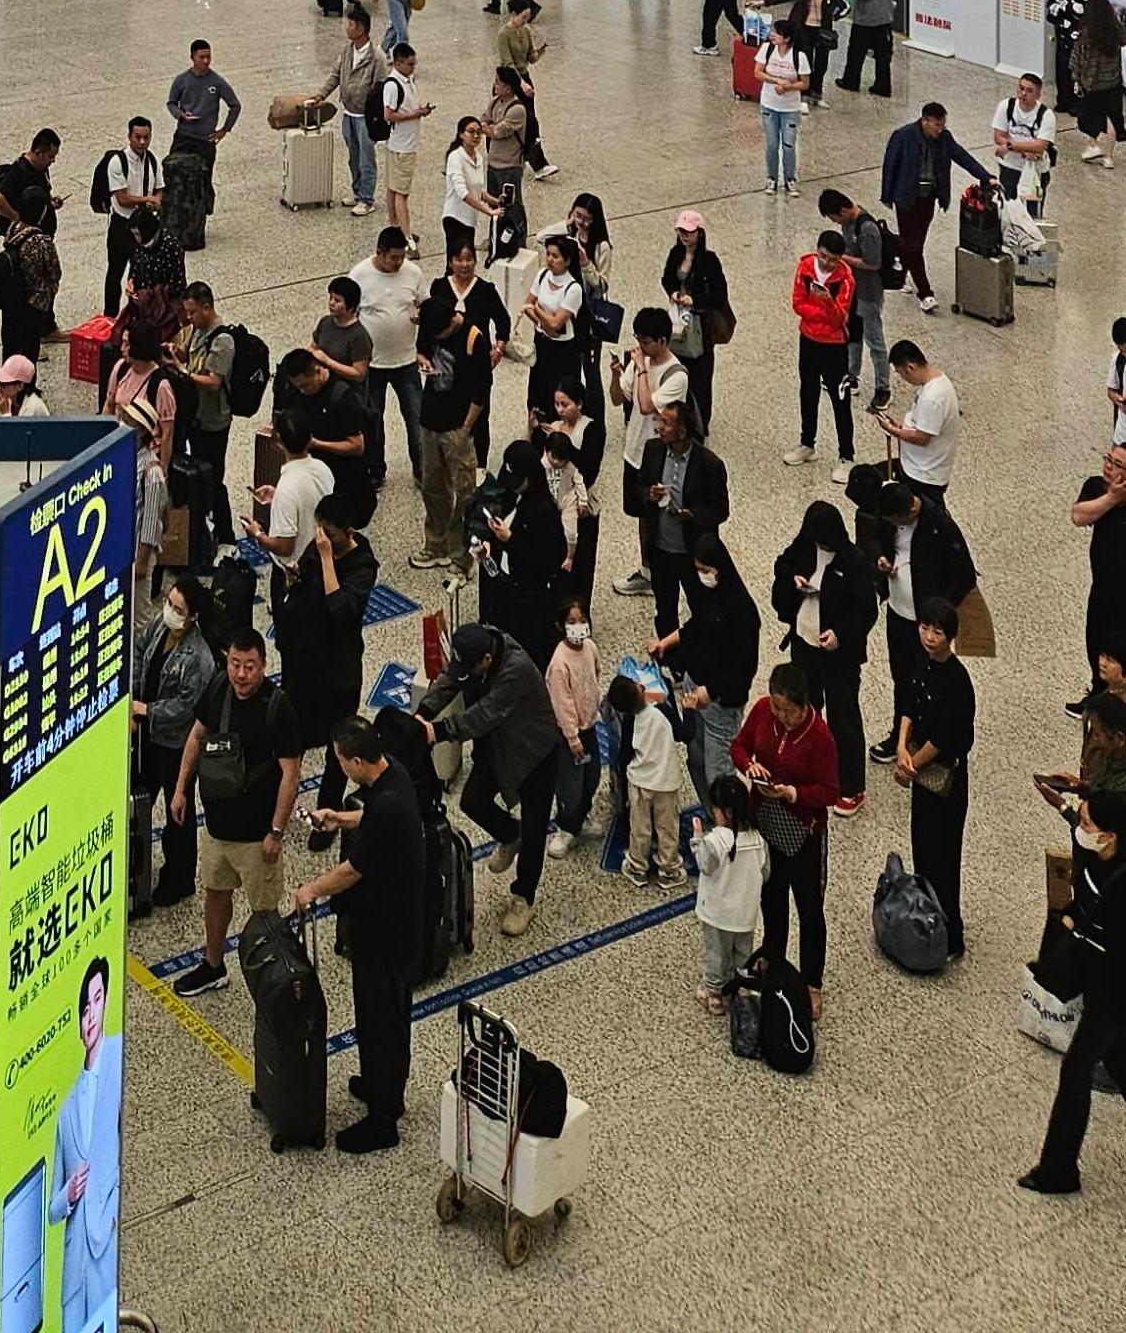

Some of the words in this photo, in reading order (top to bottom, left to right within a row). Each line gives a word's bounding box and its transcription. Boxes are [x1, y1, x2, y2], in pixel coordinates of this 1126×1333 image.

[30, 491, 66, 536] 检票口
[68, 469, 101, 506] Check
[103, 463, 113, 483] in
[31, 496, 107, 635] A2
[10, 675, 120, 790] 开车前4分钟停止检票
[9, 811, 114, 936] 高端智能垃圾桶
[10, 804, 48, 870] EKO
[7, 907, 113, 1022] 畅销全球100多个国家
[8, 850, 113, 993] 就选EKO
